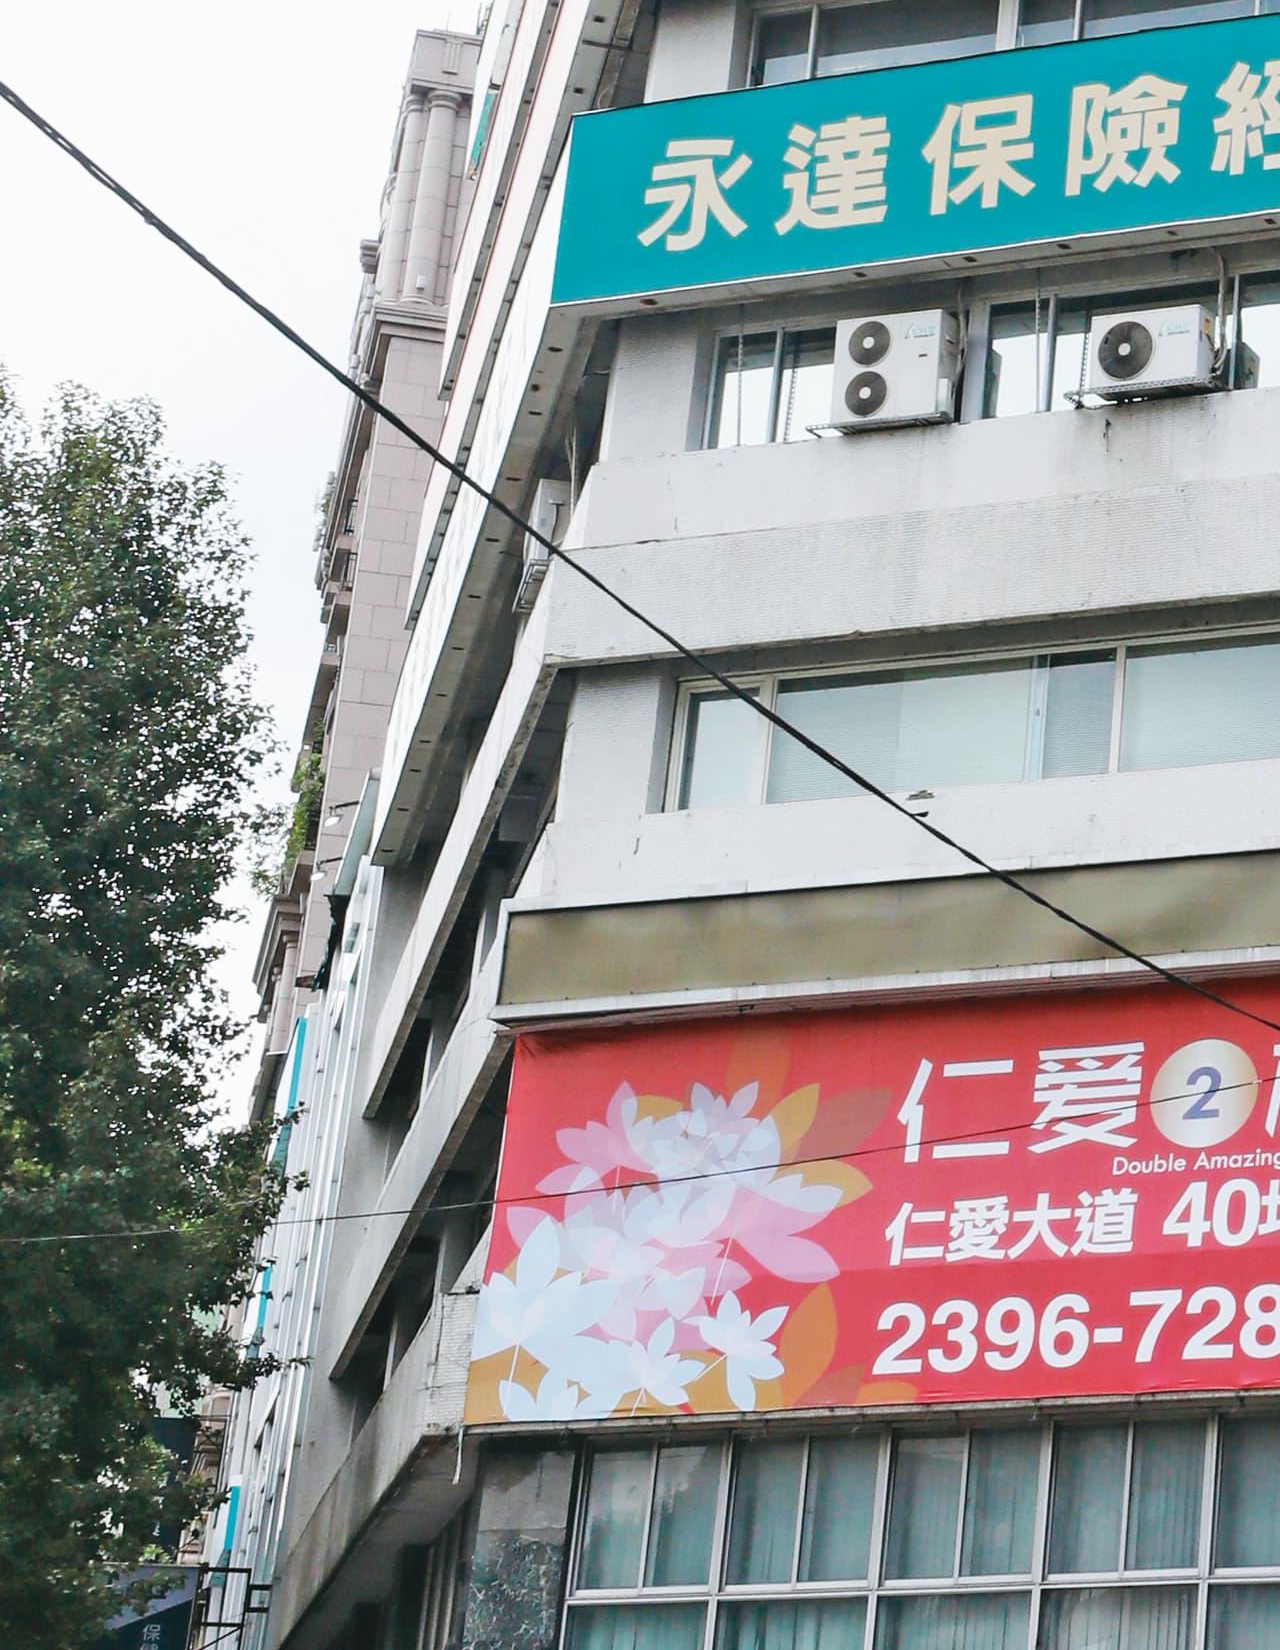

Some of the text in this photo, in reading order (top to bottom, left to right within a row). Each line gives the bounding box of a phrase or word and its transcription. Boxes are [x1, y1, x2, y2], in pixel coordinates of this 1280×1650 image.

[1112, 1153, 1187, 1176] Double
[884, 1187, 1138, 1266] 仁愛大道
